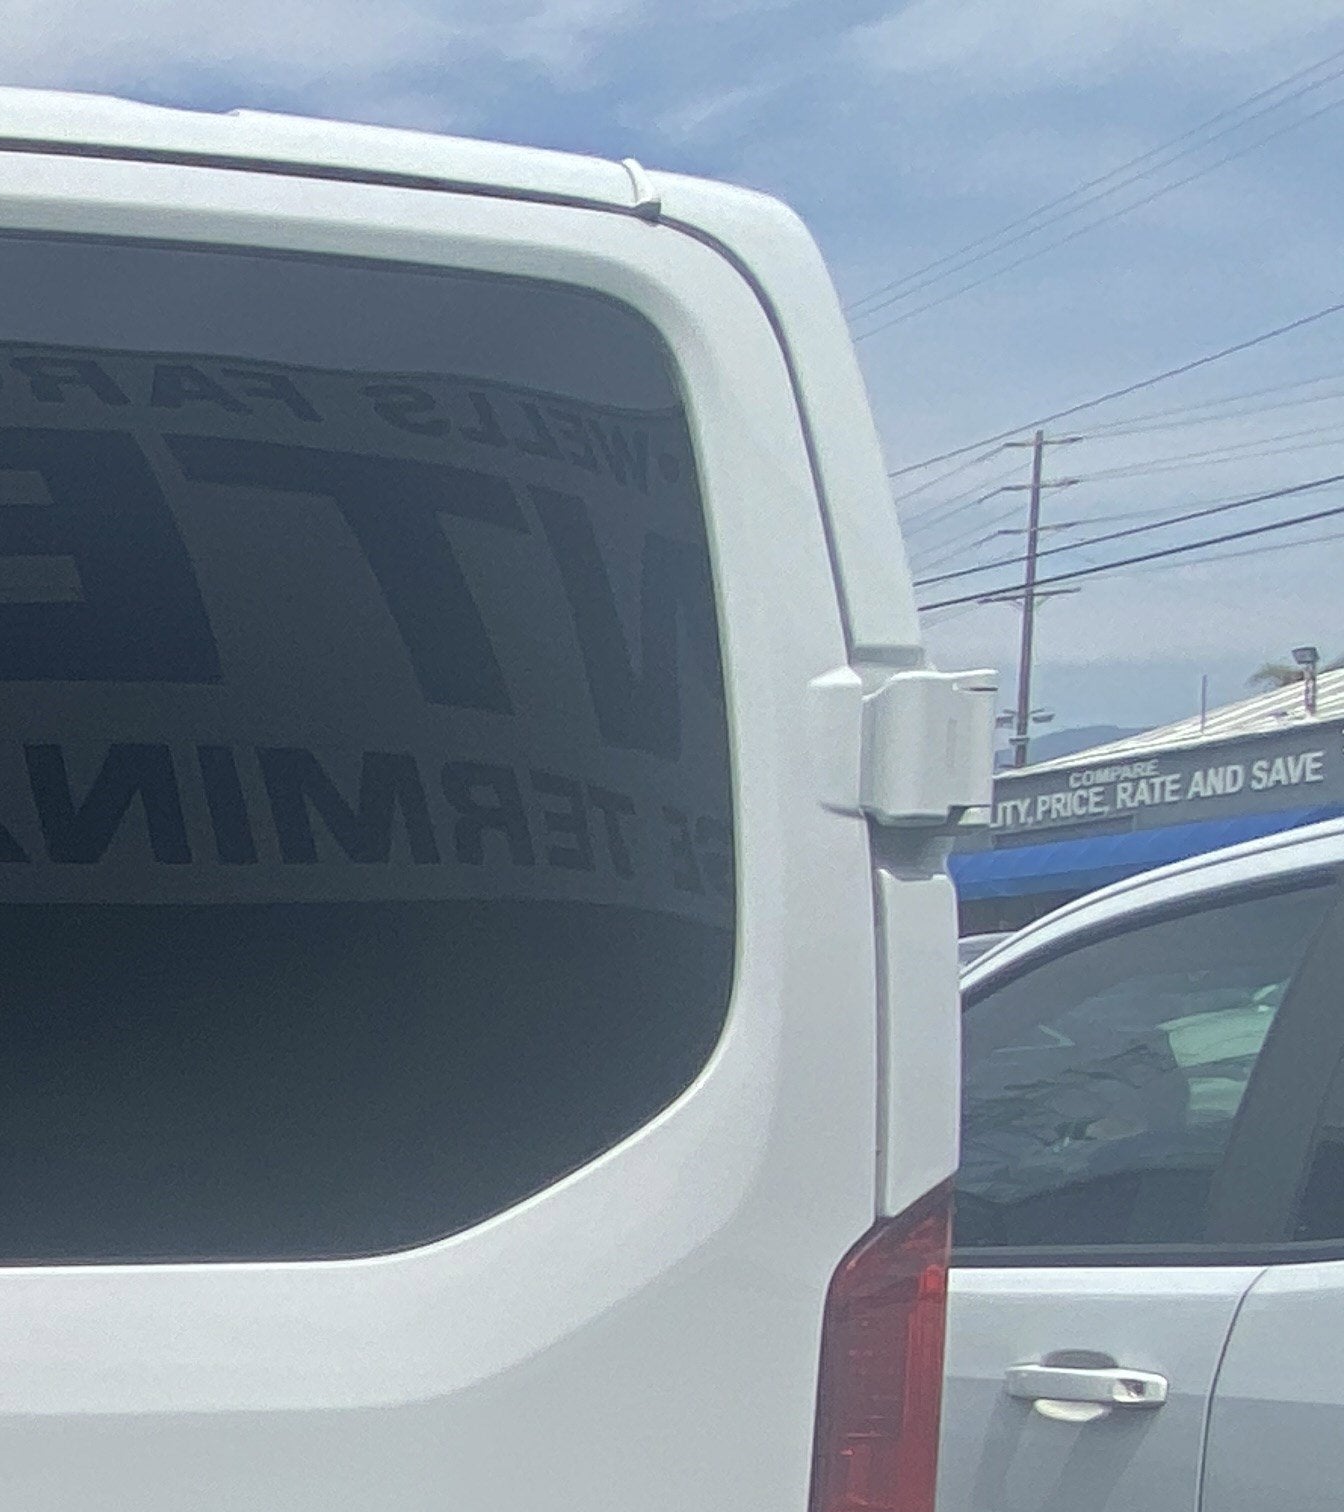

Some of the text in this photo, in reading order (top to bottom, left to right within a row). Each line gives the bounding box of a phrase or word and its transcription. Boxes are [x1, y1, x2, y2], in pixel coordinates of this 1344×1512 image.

[1068, 758, 1160, 789] COMPARE
[1116, 772, 1182, 810] RATE
[1186, 762, 1246, 801] AND
[1250, 750, 1327, 791] SAVE
